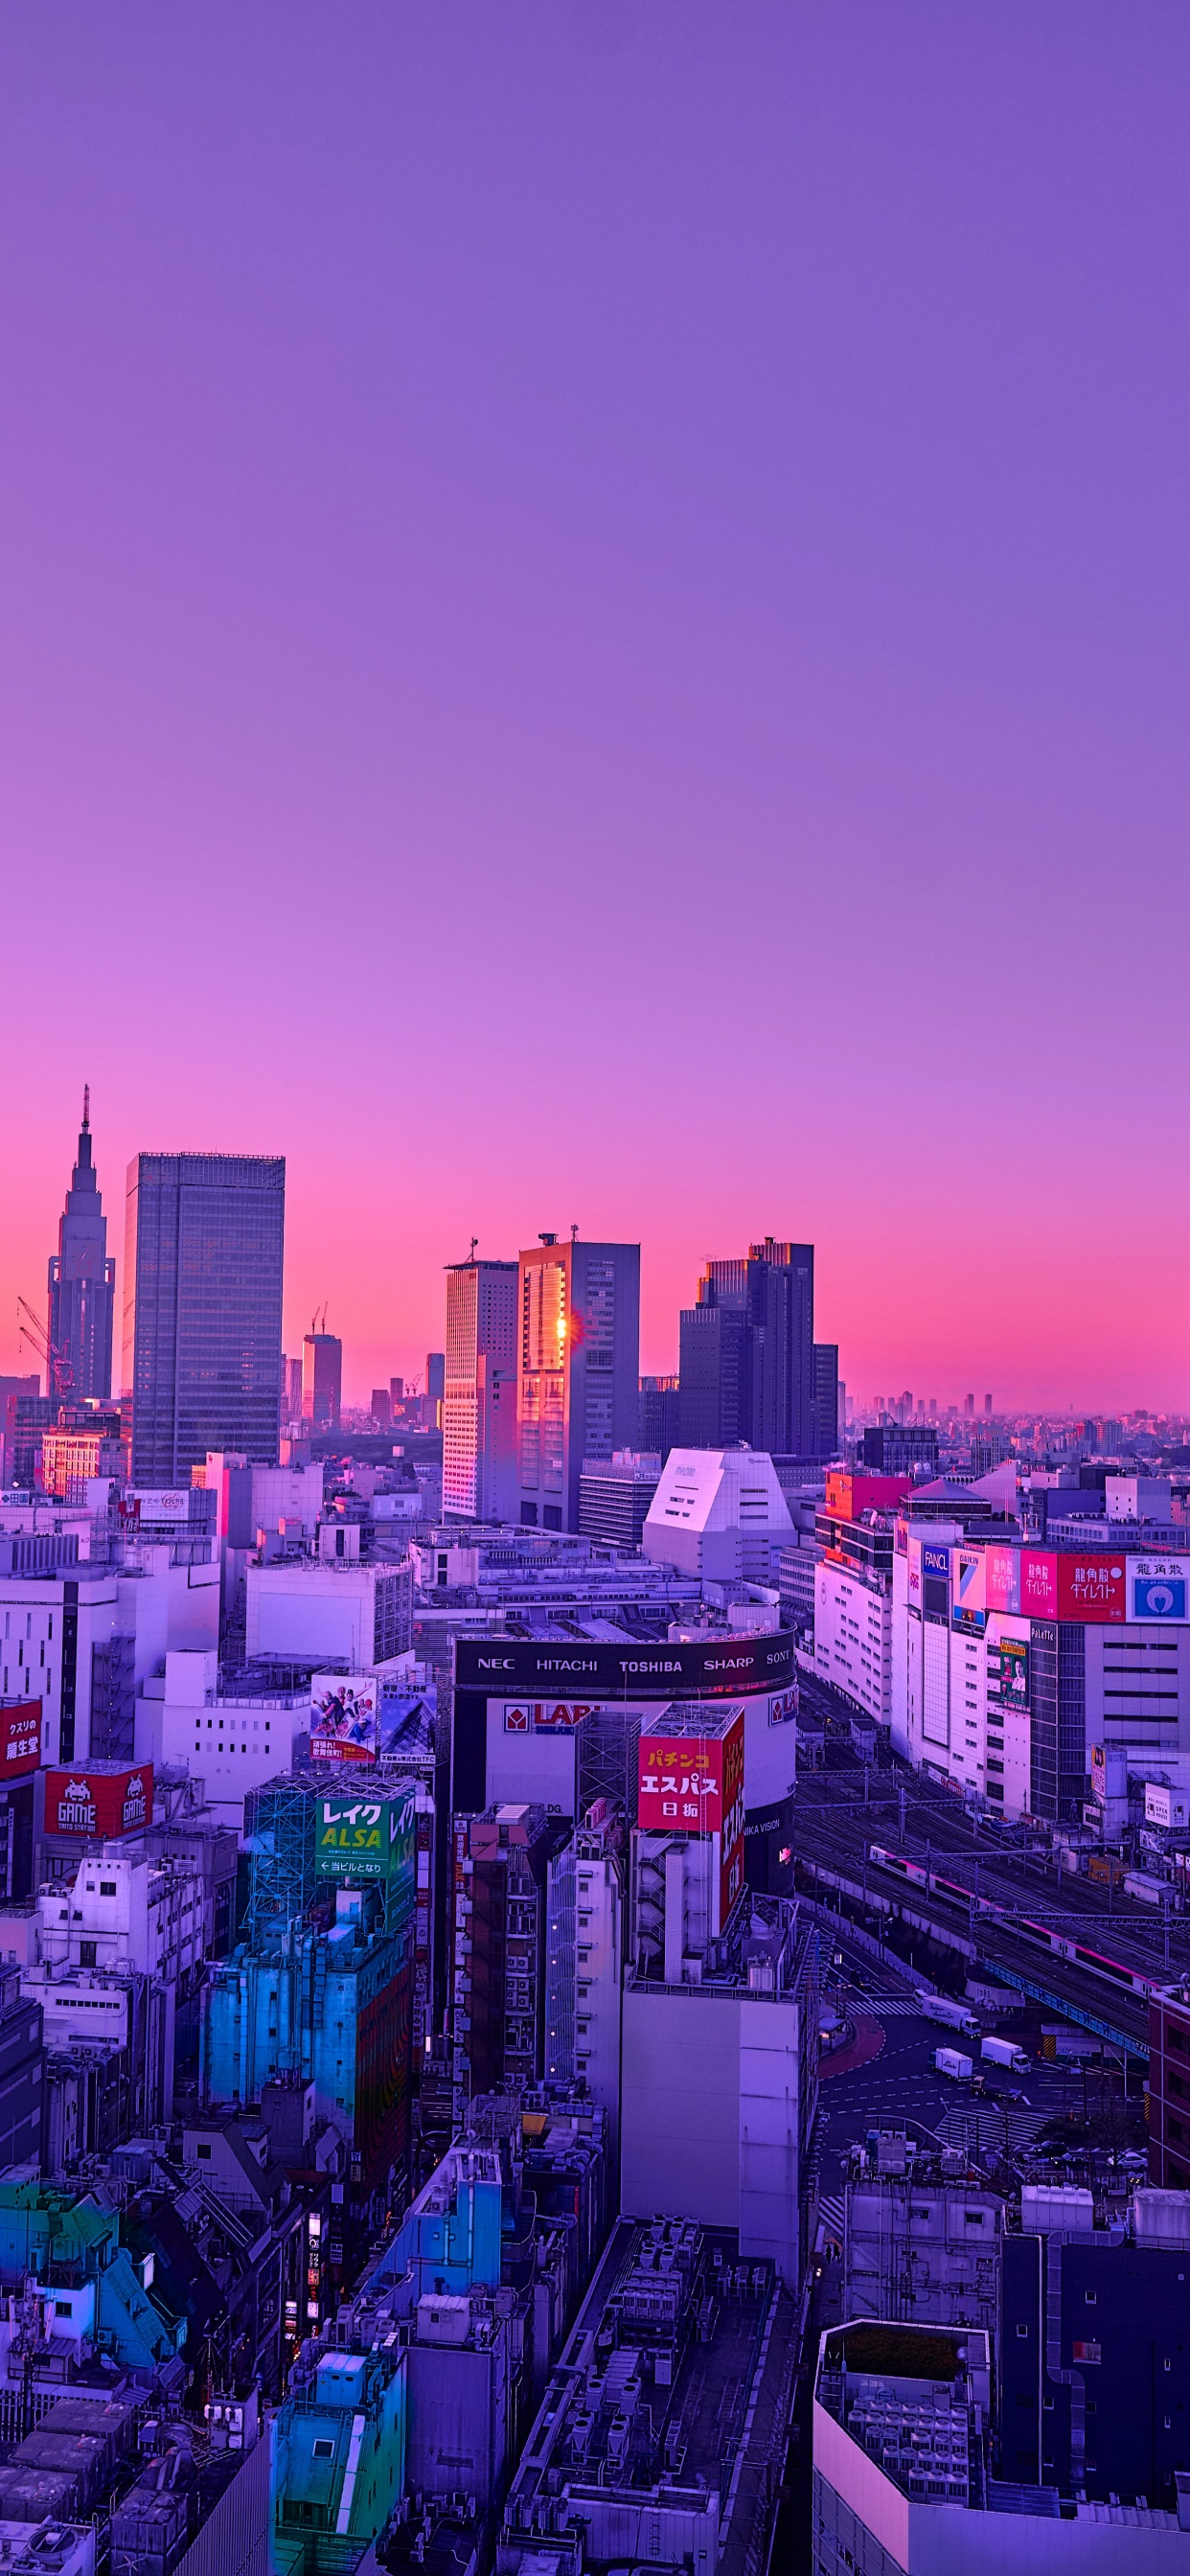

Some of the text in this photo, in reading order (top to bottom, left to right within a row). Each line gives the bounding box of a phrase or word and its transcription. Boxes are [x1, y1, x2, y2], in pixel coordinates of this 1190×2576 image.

[925, 1551, 949, 1571] FANCL
[960, 1554, 979, 1565] DAIKIN
[1075, 1567, 1110, 1583] 龍角散
[1135, 1563, 1183, 1576] 龍角散
[1070, 1583, 1116, 1599] ダイレクト
[478, 1658, 515, 1669] NEC
[537, 1659, 598, 1671] HITACHI
[703, 1657, 755, 1671] SHARP
[767, 1649, 790, 1665] SONY
[619, 1661, 683, 1672] TOSHIBA
[10, 1719, 36, 1736] クスリの
[6, 1736, 38, 1760] 龍生堂
[648, 1749, 710, 1769] パチンコ
[640, 1773, 720, 1796] エスパス
[58, 1802, 96, 1825] GAME
[123, 1795, 147, 1820] GAME
[323, 1803, 381, 1826] レイク
[74, 1824, 96, 1833] STATION
[760, 1819, 780, 1832] VISION
[321, 1828, 381, 1849] ALSA
[331, 1861, 381, 1874] 当ビルとなり
